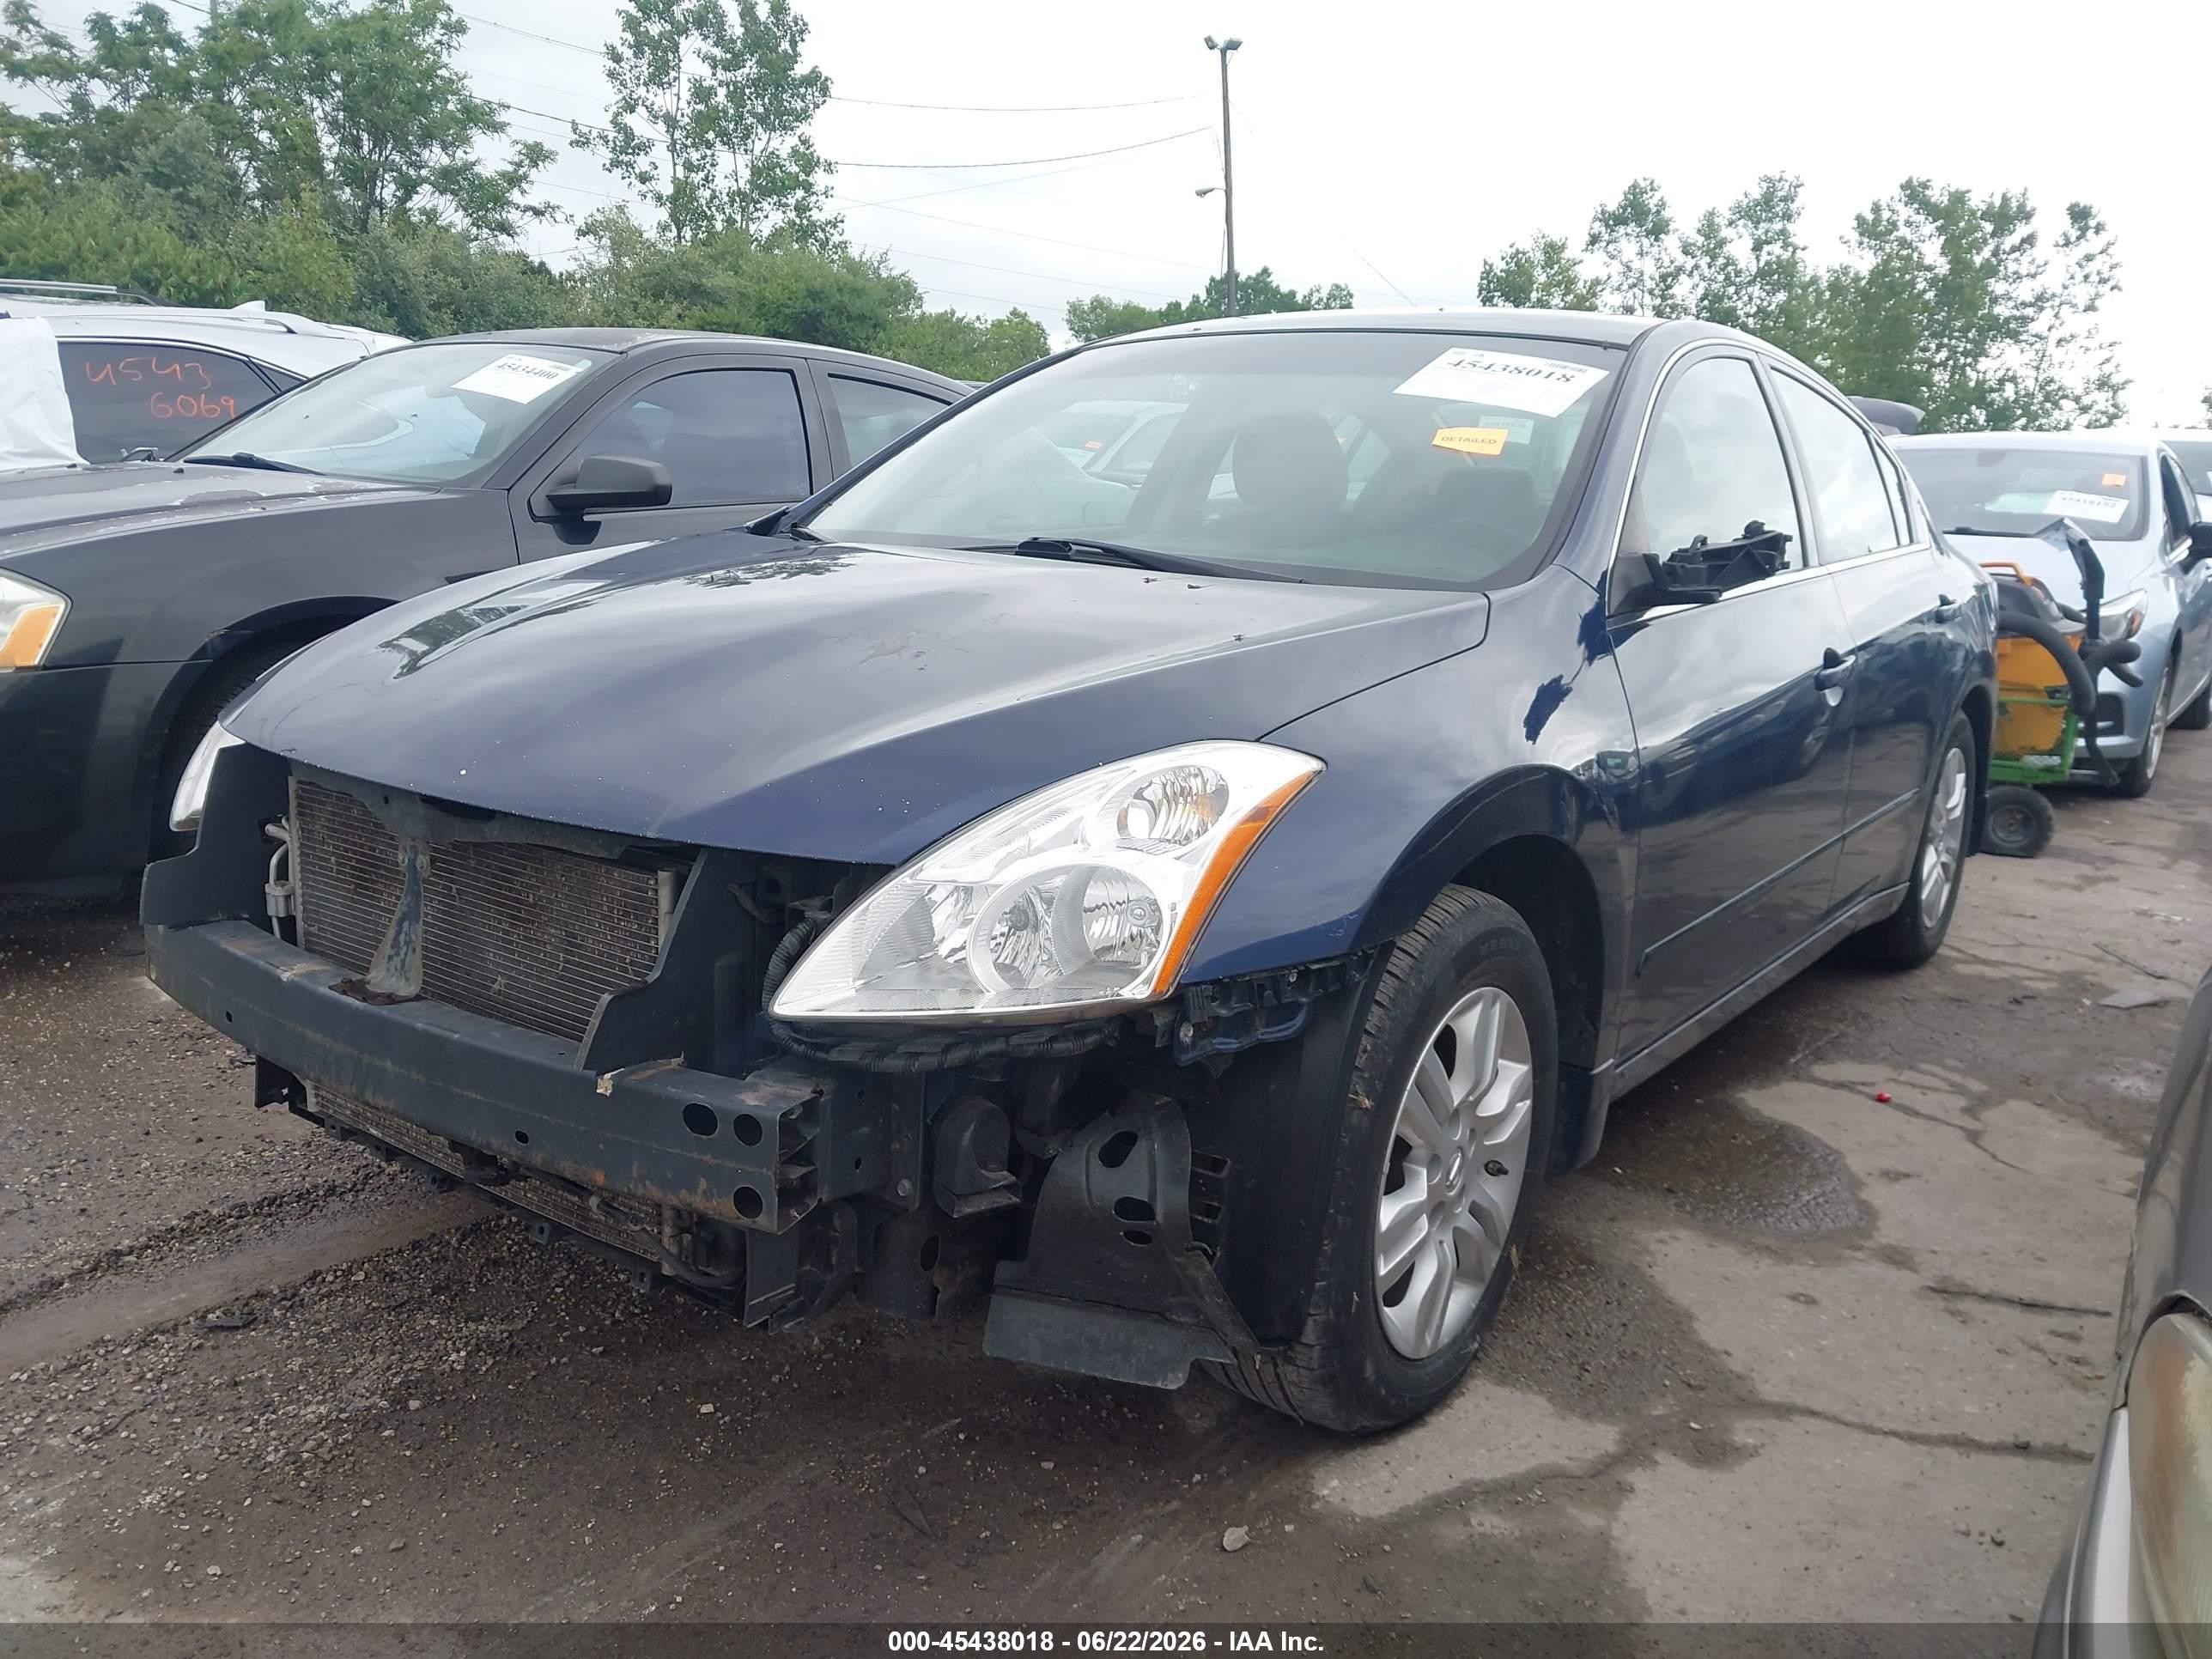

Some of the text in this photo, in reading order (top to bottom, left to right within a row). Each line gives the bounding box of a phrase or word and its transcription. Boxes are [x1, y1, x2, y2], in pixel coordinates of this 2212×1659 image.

[86, 356, 211, 390] 4543
[495, 362, 559, 380] 45434400
[1447, 359, 1576, 383] 45438018
[150, 392, 235, 419] 6069
[1441, 435, 1498, 446] DETAILED
